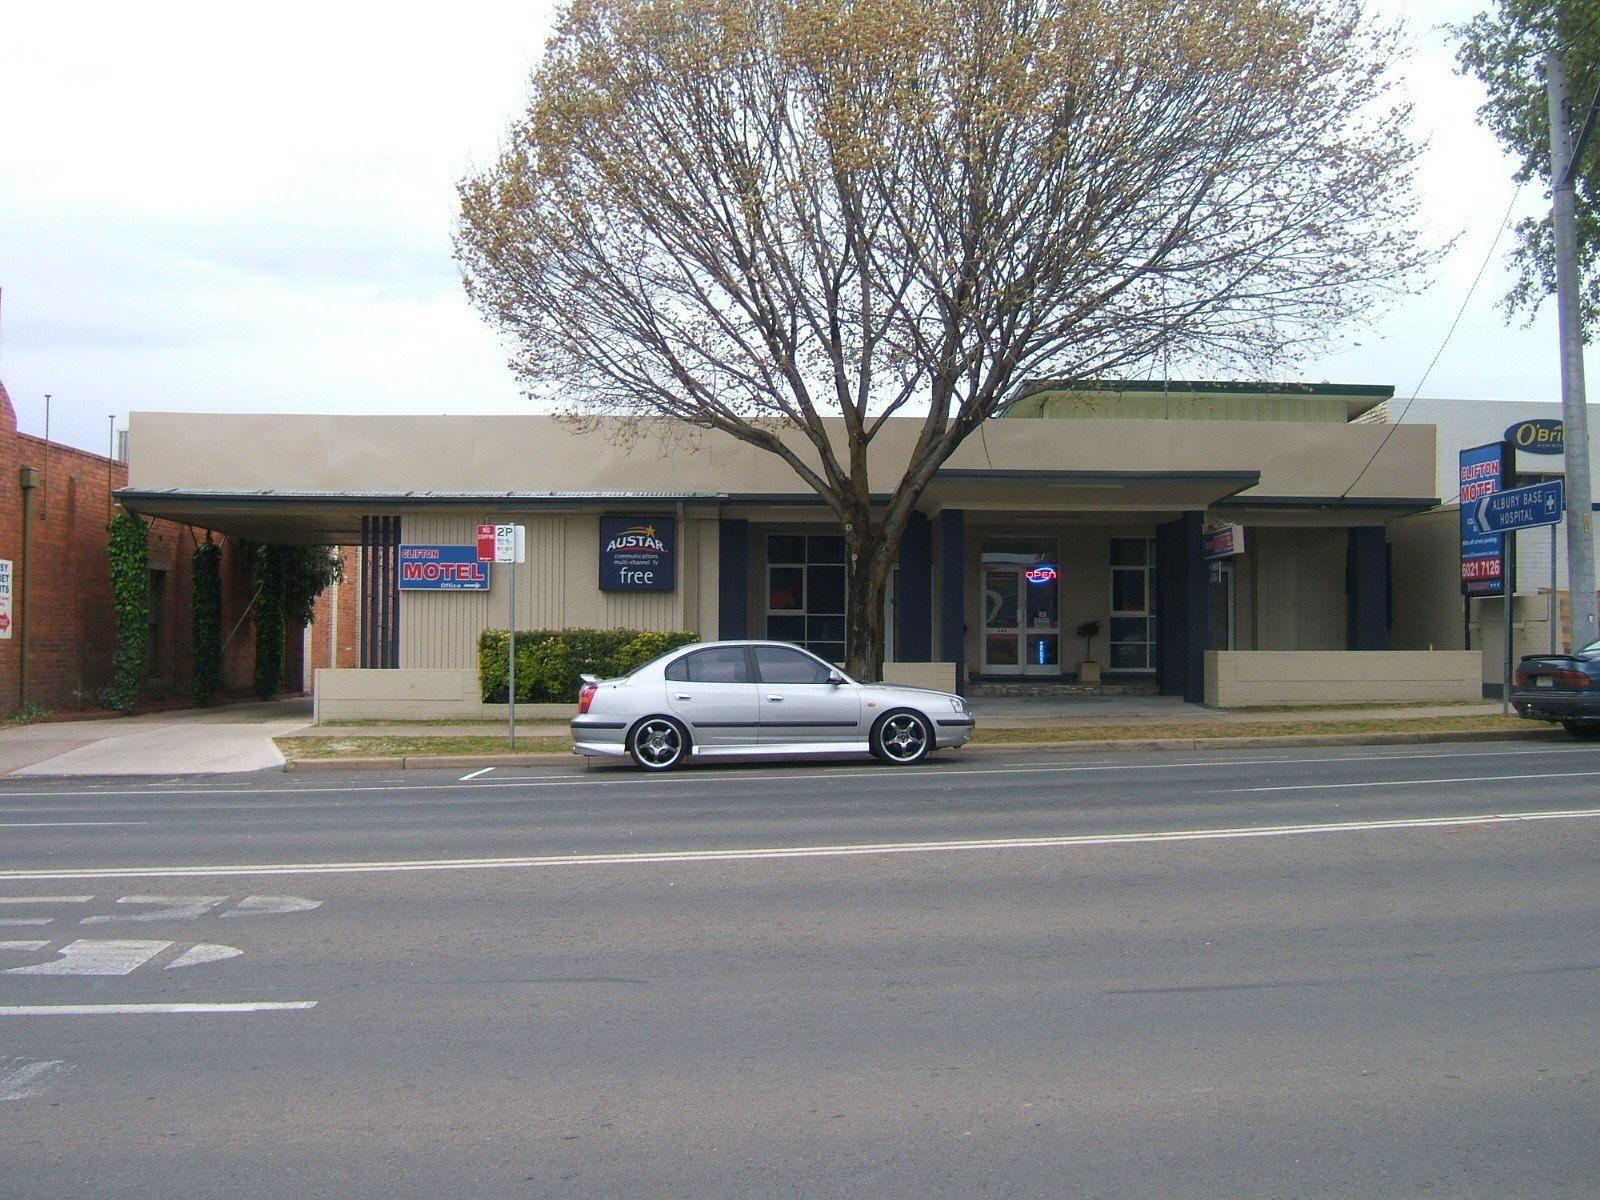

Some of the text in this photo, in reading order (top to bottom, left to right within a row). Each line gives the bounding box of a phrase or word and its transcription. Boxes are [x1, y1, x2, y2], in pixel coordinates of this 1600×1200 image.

[1516, 423, 1562, 446] O'Bri
[1461, 460, 1500, 481] CLIFTON
[1461, 479, 1499, 505] MOTEL
[1493, 490, 1542, 511] ALBURY BASE
[1500, 509, 1533, 525] HOSPITAL
[497, 527, 513, 537] 2P
[606, 535, 665, 552] AUSTAR
[401, 549, 440, 559] CLIFTON
[403, 563, 485, 581] MOTEL
[620, 567, 653, 584] free
[1462, 559, 1500, 578] 6021 7126
[0, 574, 9, 582] ET
[0, 585, 9, 593] TS
